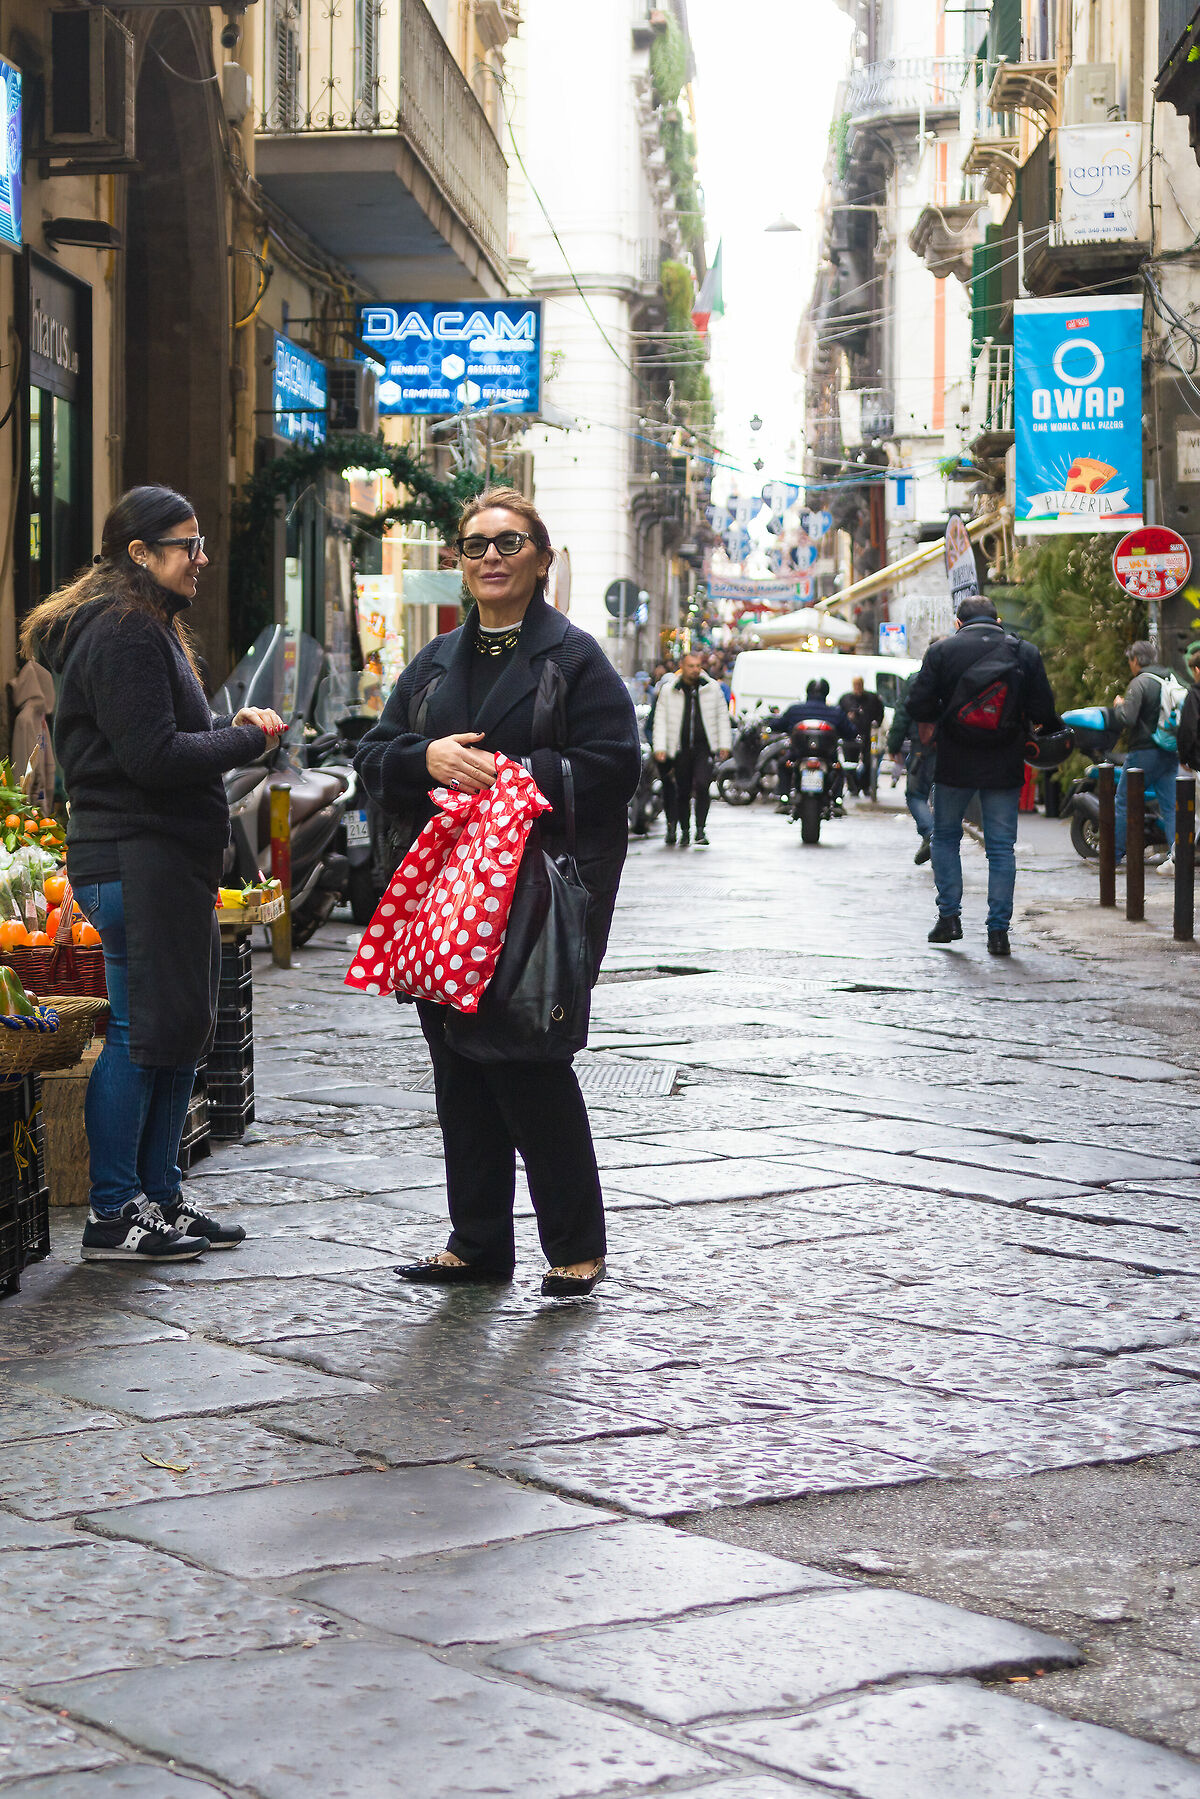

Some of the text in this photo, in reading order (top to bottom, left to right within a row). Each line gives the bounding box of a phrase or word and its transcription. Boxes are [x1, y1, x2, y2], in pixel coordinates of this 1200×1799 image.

[361, 307, 536, 341] DACAM
[467, 364, 521, 376] ASSISTENZA
[403, 388, 450, 399] COMPUTER
[1032, 387, 1125, 420] OWAP
[1033, 422, 1048, 432] ONE
[1082, 421, 1096, 431] ALL
[1098, 420, 1124, 430] PIZZAS
[1044, 494, 1113, 514] PIZZERIA
